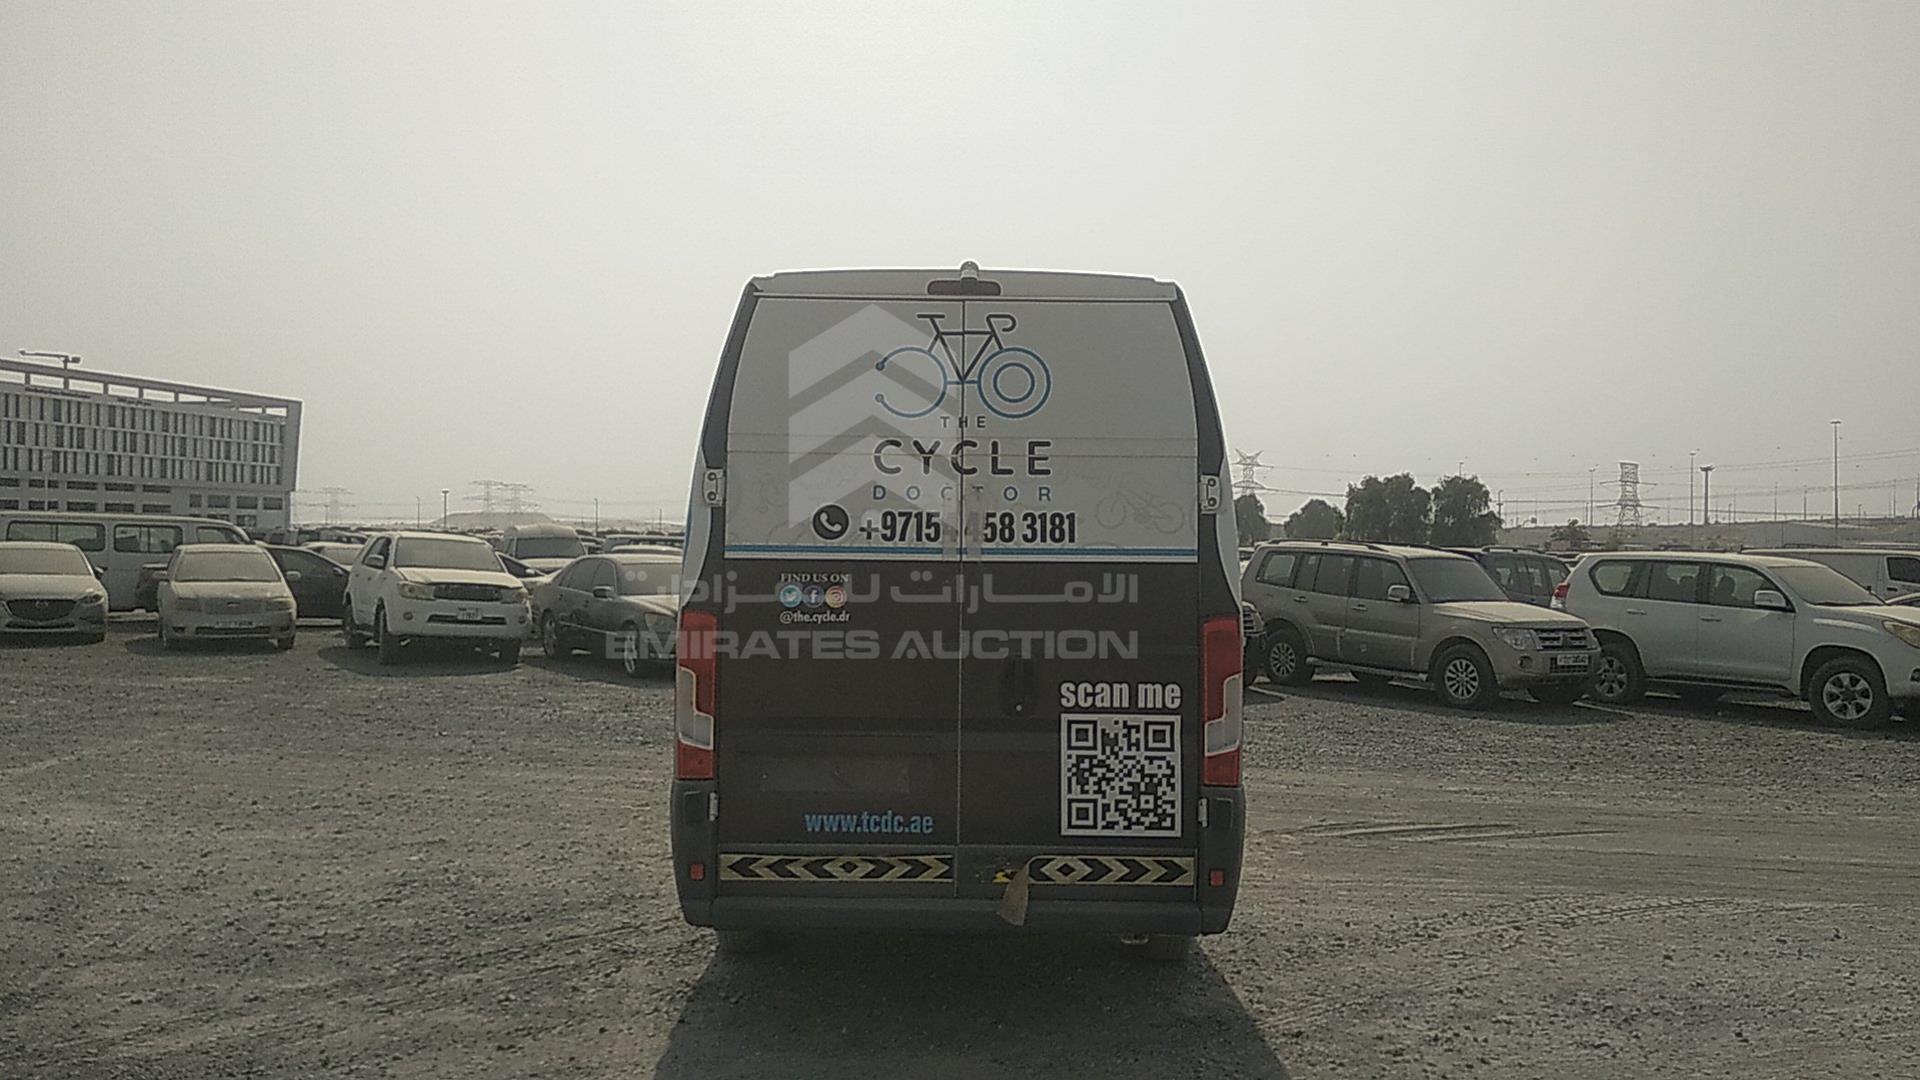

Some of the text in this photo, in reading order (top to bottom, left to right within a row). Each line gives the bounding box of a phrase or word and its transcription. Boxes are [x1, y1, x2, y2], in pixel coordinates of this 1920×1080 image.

[940, 416, 986, 428] THE
[873, 439, 1051, 475] CYCLE
[859, 511, 958, 543] +9715
[1022, 512, 1076, 543] 3181
[781, 573, 849, 582] FIND US ON
[780, 610, 850, 624] @the.cycle.dr
[1060, 682, 1181, 709] scan me
[804, 810, 934, 834] www.tcdc.ae
